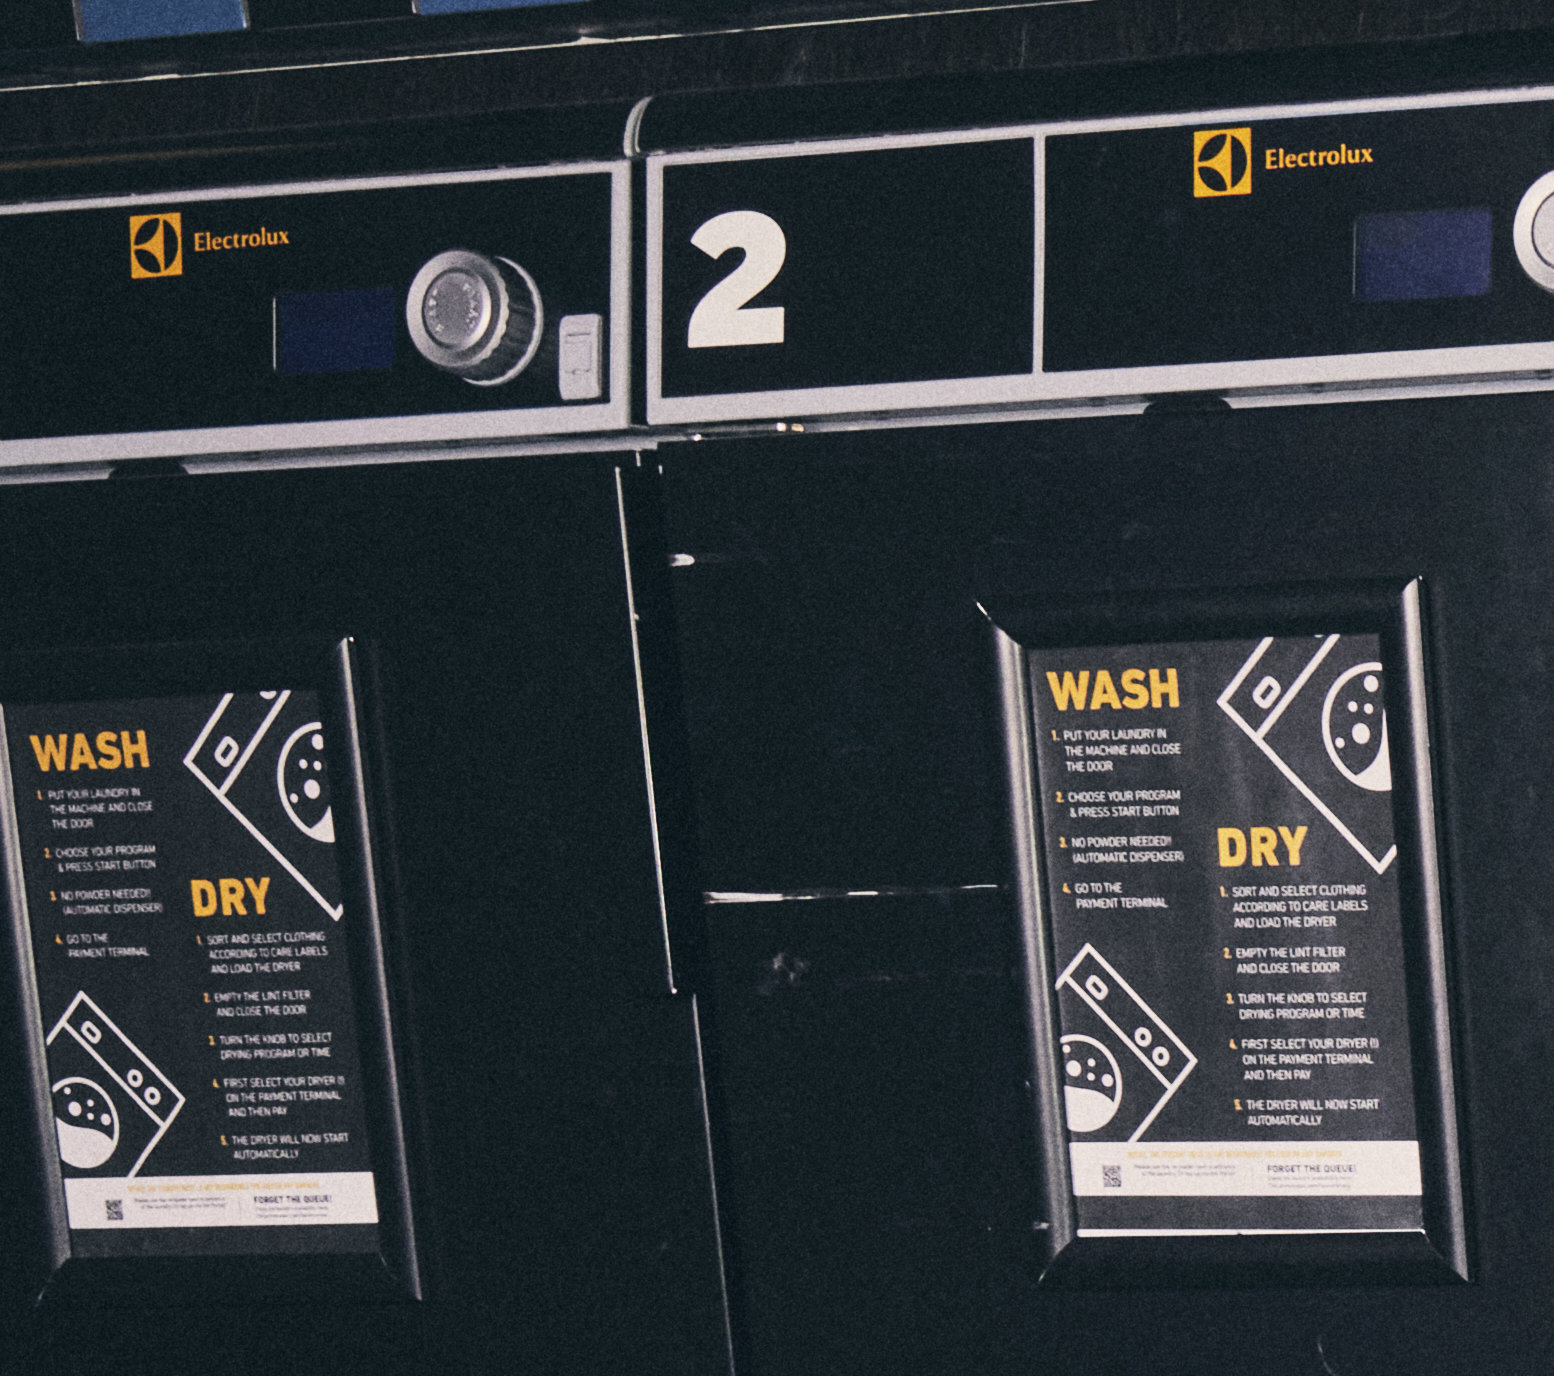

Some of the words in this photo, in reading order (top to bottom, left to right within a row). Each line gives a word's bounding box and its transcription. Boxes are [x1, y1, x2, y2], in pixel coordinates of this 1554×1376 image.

[1265, 143, 1374, 170] Electrolux
[194, 226, 289, 252] Electrolux
[688, 211, 785, 348] 2
[1046, 667, 1180, 711] WASH
[29, 729, 151, 772] WASH
[1068, 791, 1106, 803] CHOOSE
[1107, 790, 1134, 802] YOUR
[1135, 790, 1180, 801] PROGRAM
[1217, 825, 1308, 868] DRY
[190, 876, 271, 918] DRY
[1304, 1164, 1321, 1173] THE
